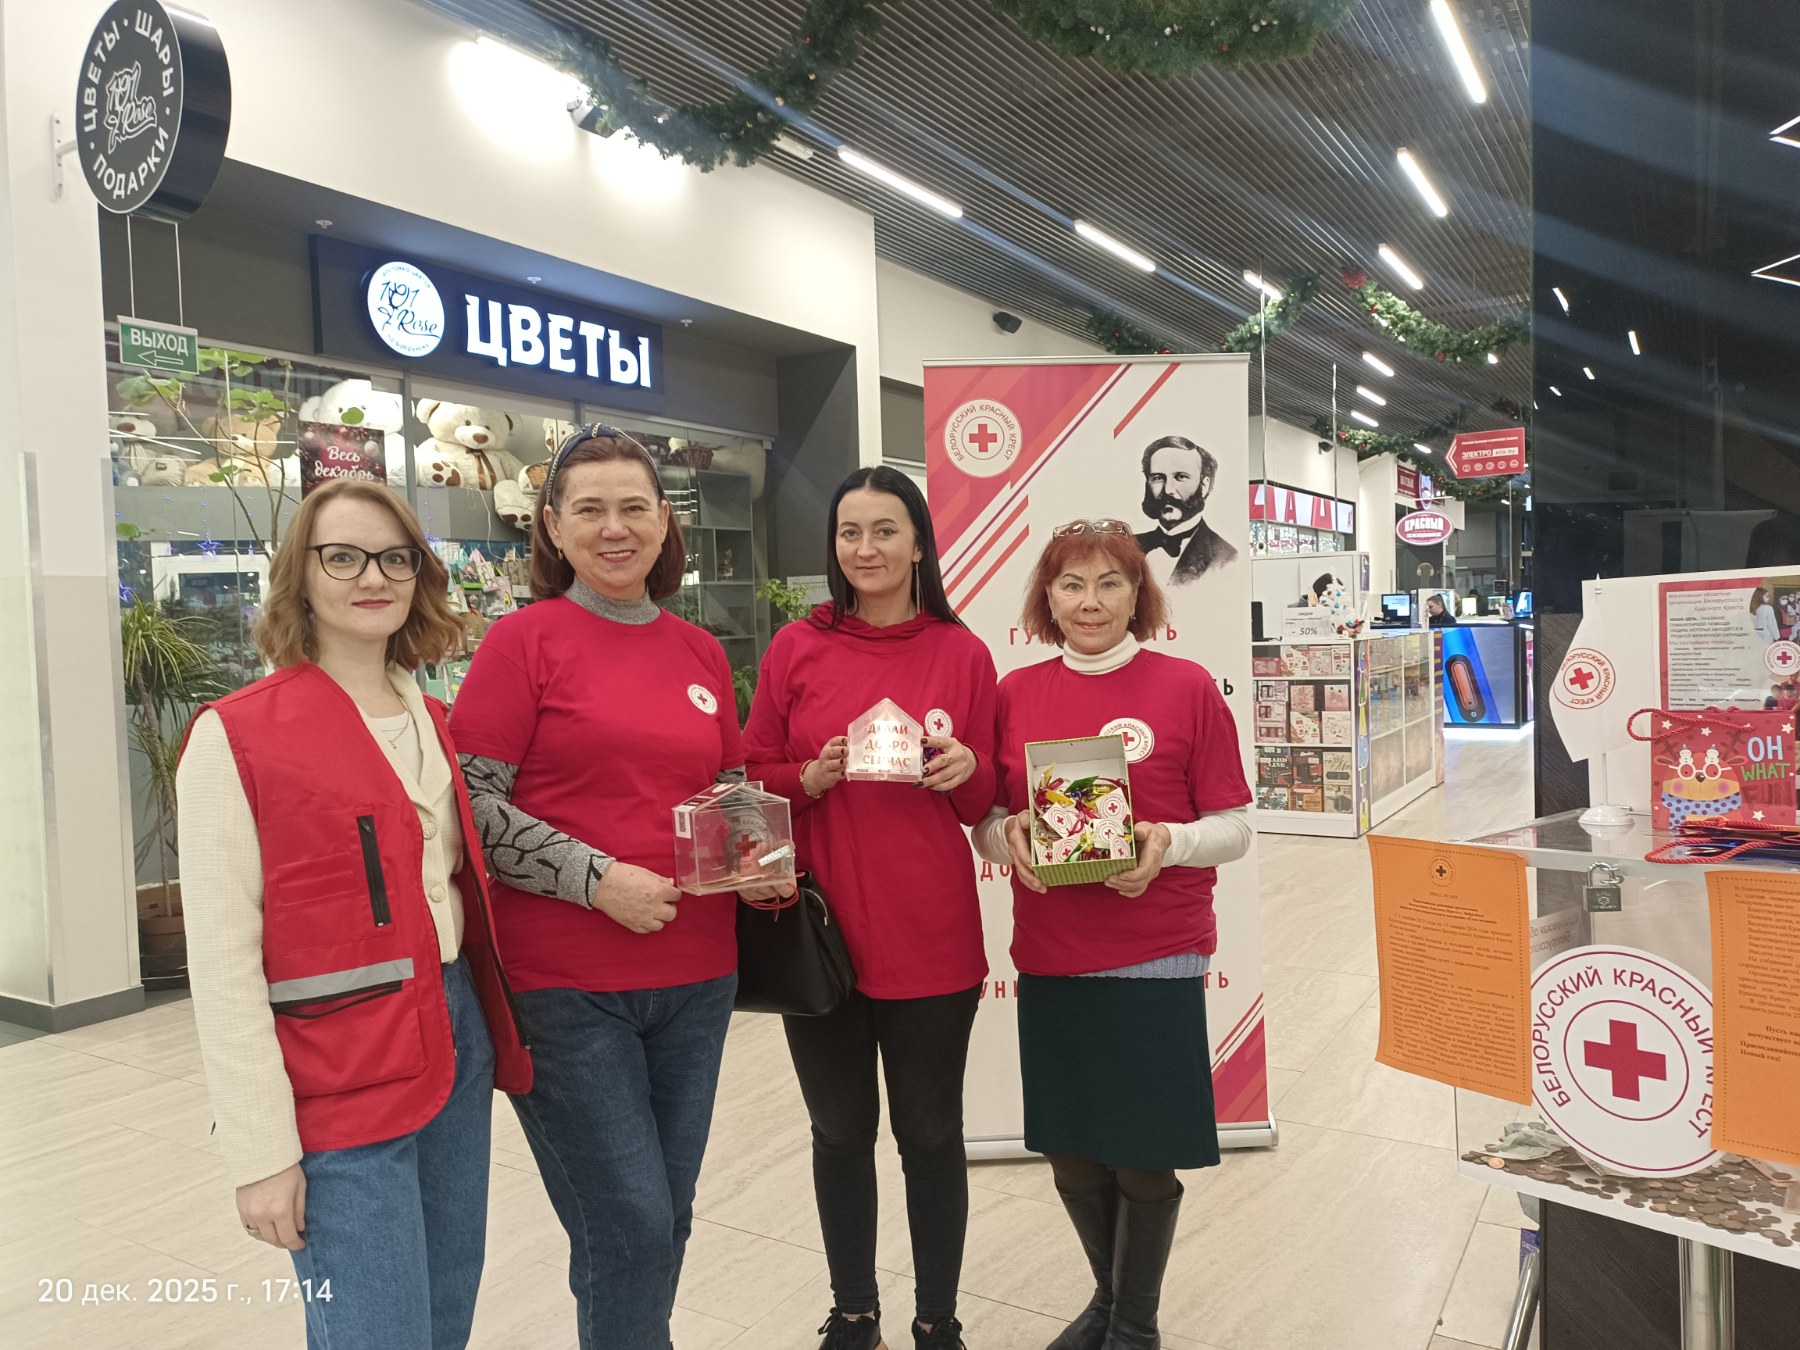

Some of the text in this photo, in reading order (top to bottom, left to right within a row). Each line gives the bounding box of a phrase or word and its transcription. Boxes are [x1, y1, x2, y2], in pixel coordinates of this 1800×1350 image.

[84, 9, 175, 200] ЦВЕТЫ ШАРЫ ПОДАРКИ
[130, 328, 188, 356] ВЫХОД
[464, 293, 651, 388] ЦВЕТЫ
[949, 404, 1017, 462] БЕЛОРУССКИЙ КРАСНЫЙ КРЕСТ
[326, 446, 361, 463] Весь
[314, 460, 375, 482] декабрь
[1299, 627, 1318, 635] 50%
[1595, 667, 1611, 700] КРАСНЫЙ
[1570, 697, 1594, 705] КРЕСТ
[867, 724, 908, 735] ДАЙ
[865, 739, 908, 751] ДОРО
[1747, 735, 1784, 762] OH
[862, 755, 911, 767] СЕЧАС
[1740, 763, 1791, 781] WHAT
[1532, 965, 1603, 1107] БЕЛОРУССКИЙ
[1613, 968, 1713, 1054] КРАСНЫЙ
[1688, 1065, 1713, 1138] ЕСТ
